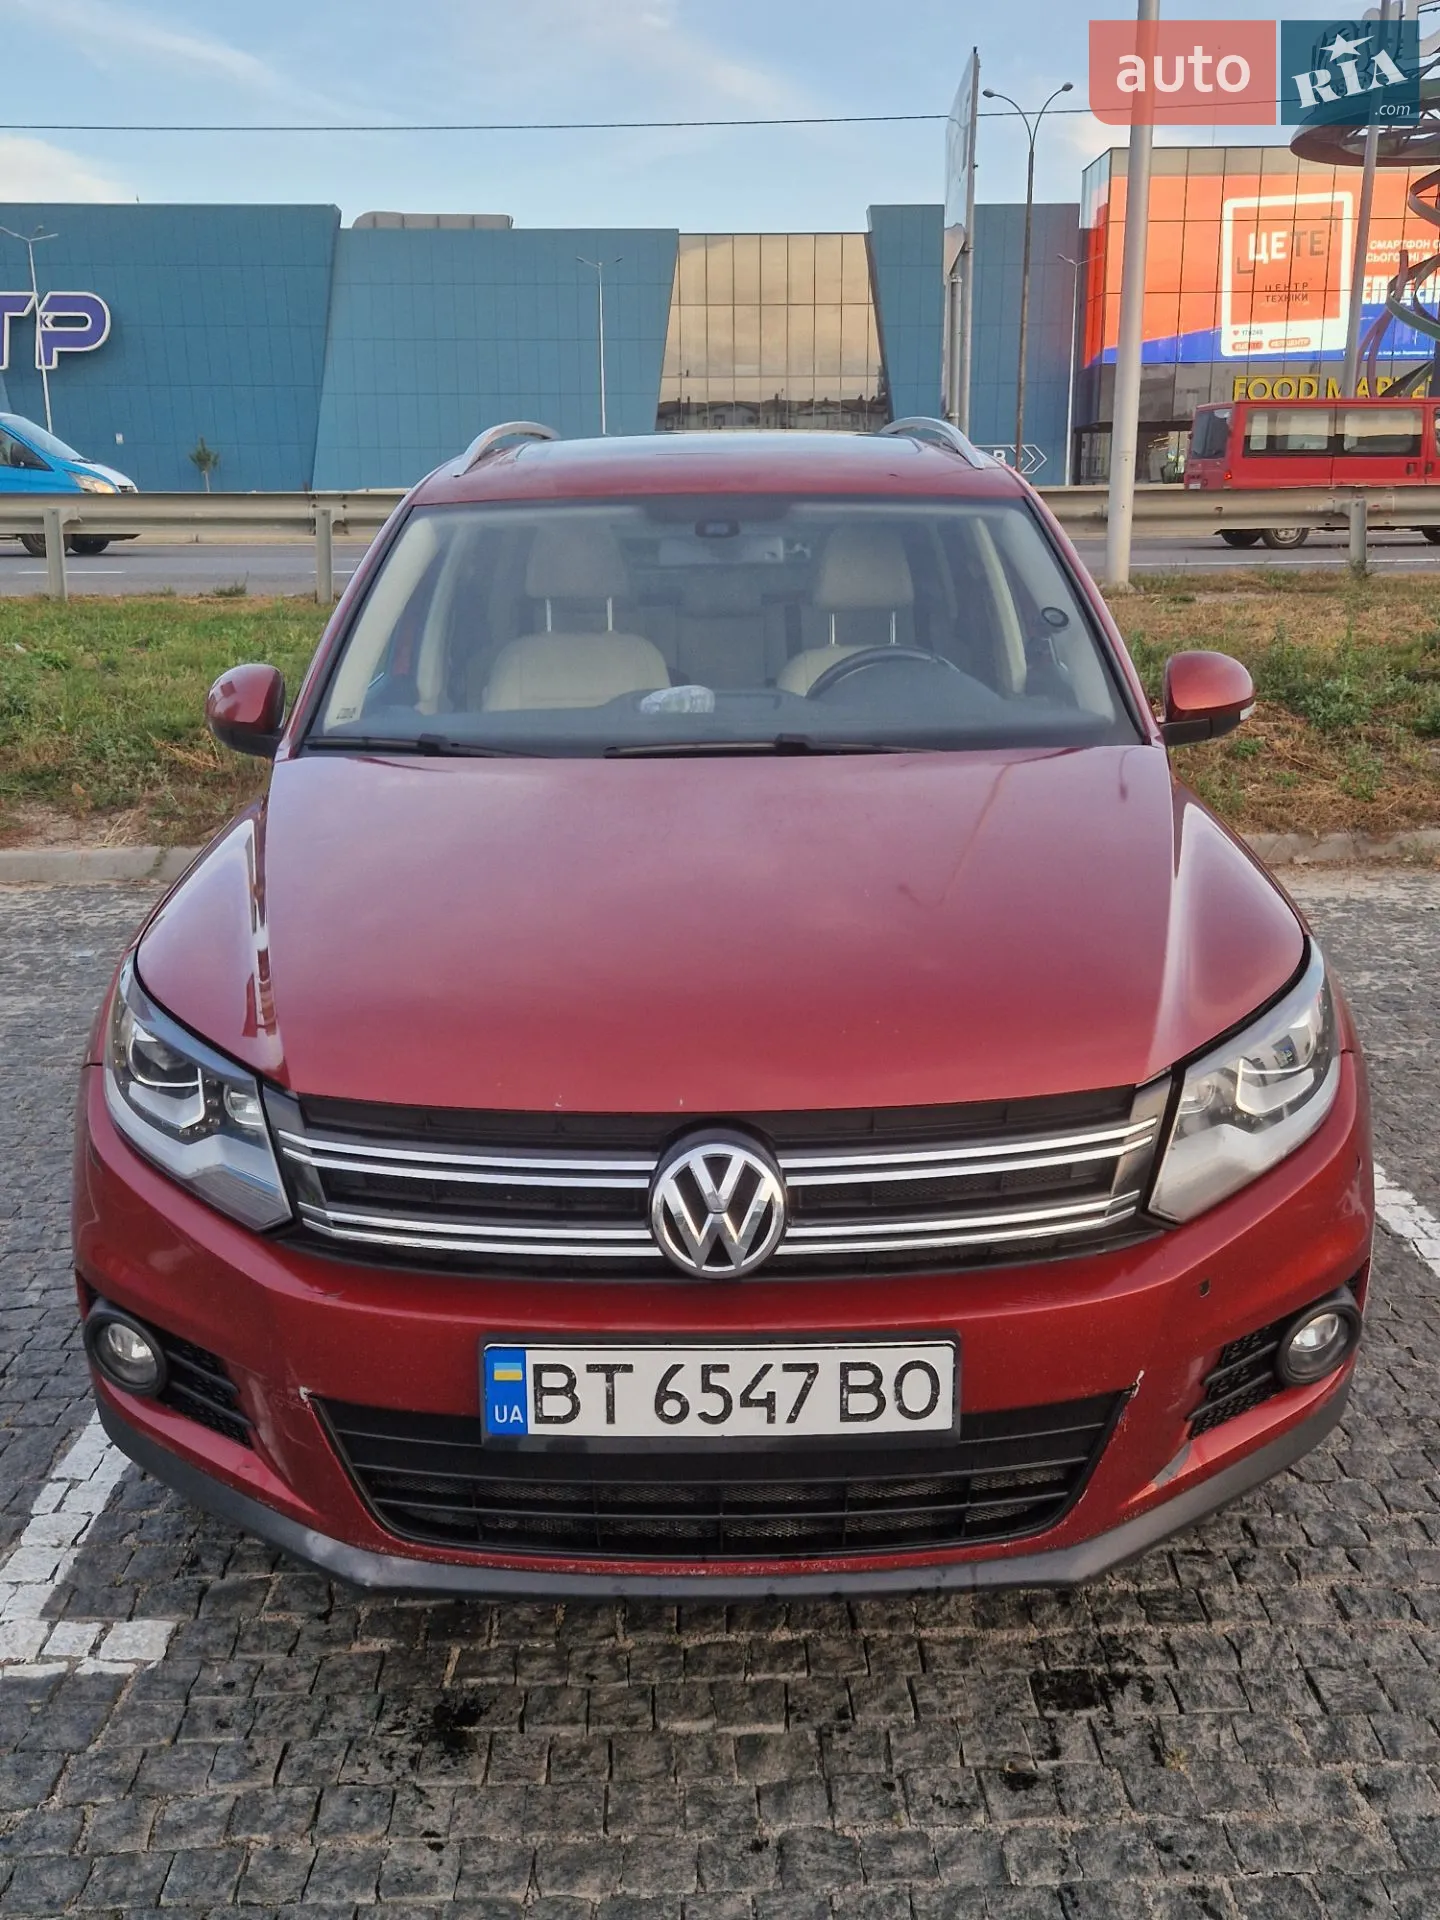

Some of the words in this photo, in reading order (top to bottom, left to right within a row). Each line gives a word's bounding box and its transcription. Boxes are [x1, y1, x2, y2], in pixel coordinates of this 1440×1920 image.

[1248, 230, 1325, 264] ЦЕТЕ
[1233, 376, 1318, 400] FOOD
[494, 1404, 524, 1424] UA
[532, 1363, 634, 1425] BT
[653, 1362, 820, 1425] 6547
